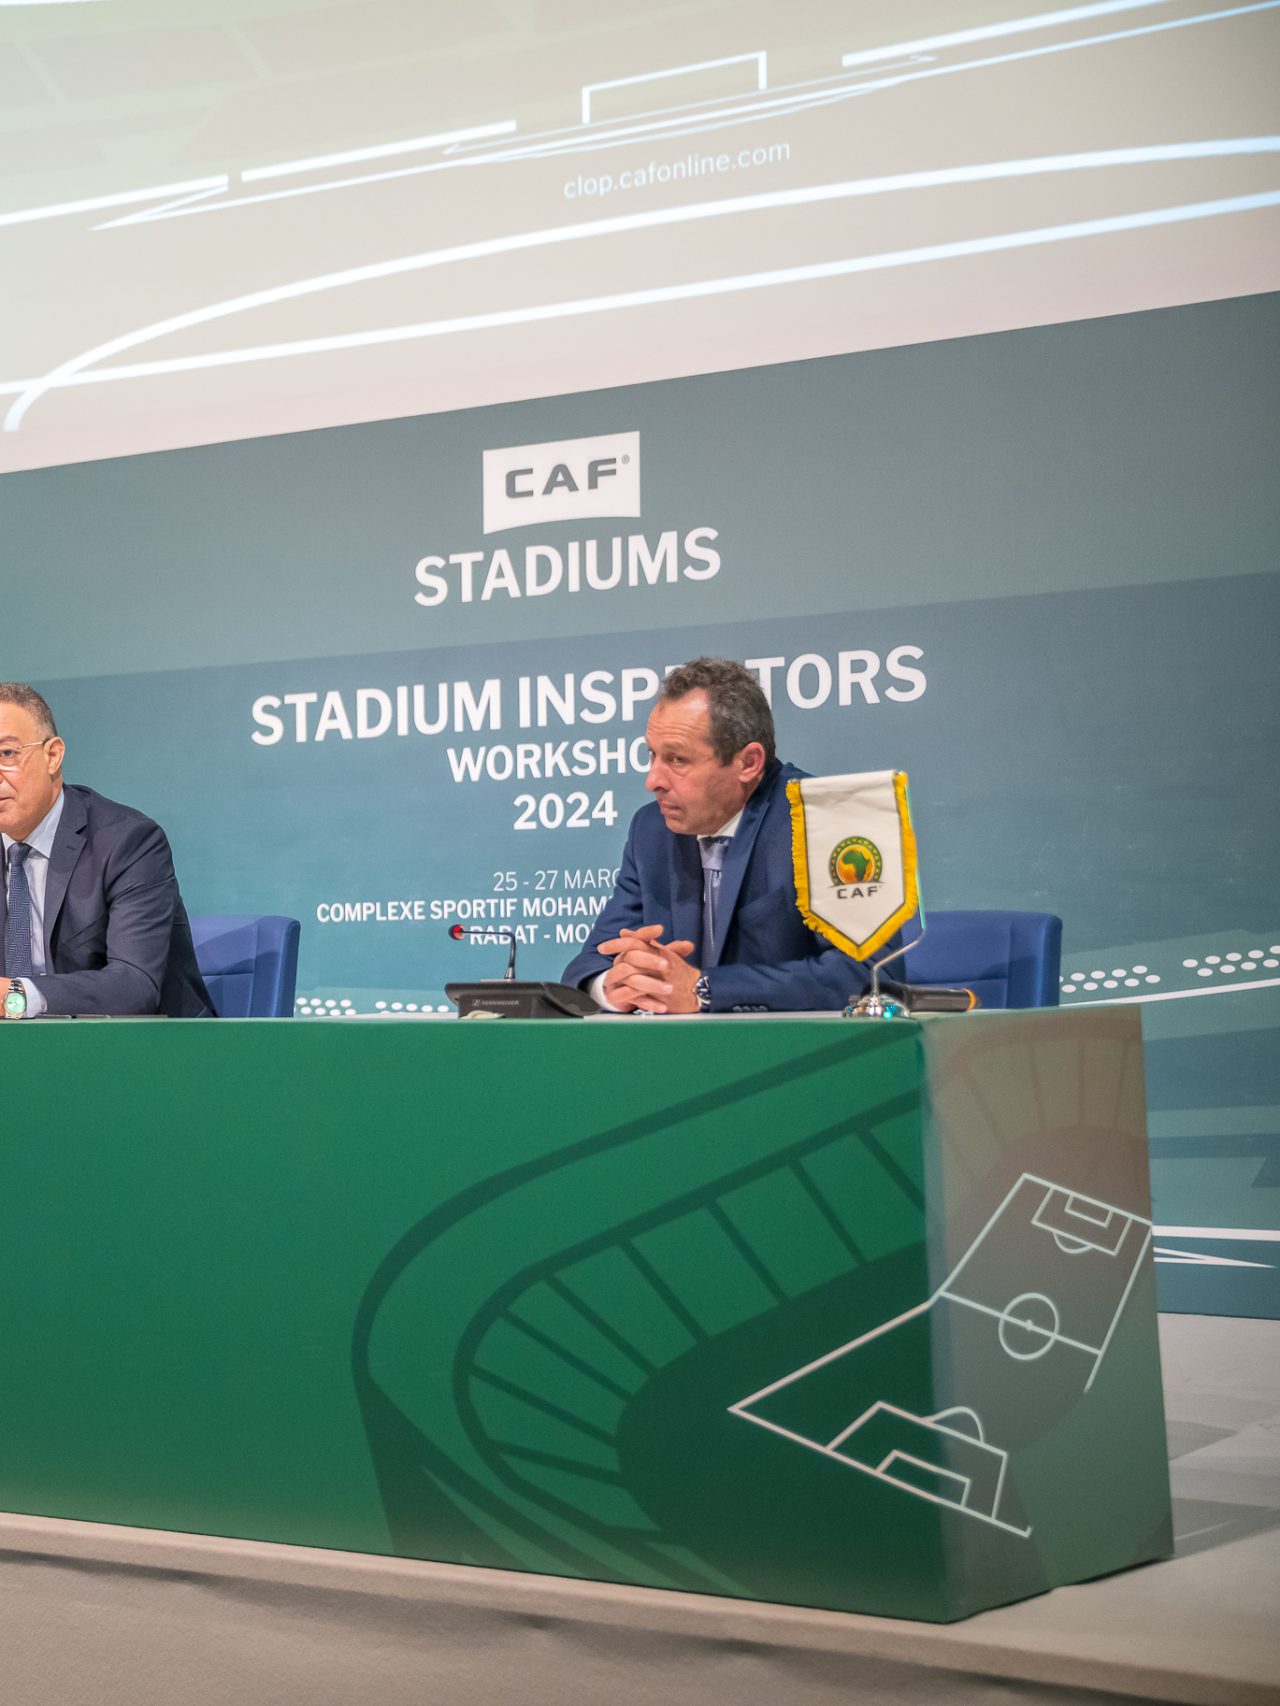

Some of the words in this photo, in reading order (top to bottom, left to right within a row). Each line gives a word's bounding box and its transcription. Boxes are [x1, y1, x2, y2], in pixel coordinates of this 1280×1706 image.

[563, 141, 792, 199] clop.cafonline.com
[414, 526, 721, 607] STADIUMS
[251, 678, 502, 746] STADIUM
[520, 644, 927, 729] INSPTORS
[446, 735, 653, 784] WORKSHO
[513, 790, 618, 830] 2024
[493, 871, 518, 892] 25
[534, 869, 559, 891] 27
[836, 885, 879, 900] CAF
[316, 900, 426, 923] COMPLEXE
[429, 897, 518, 920] SPORTIF
[522, 895, 613, 917] MOHAM
